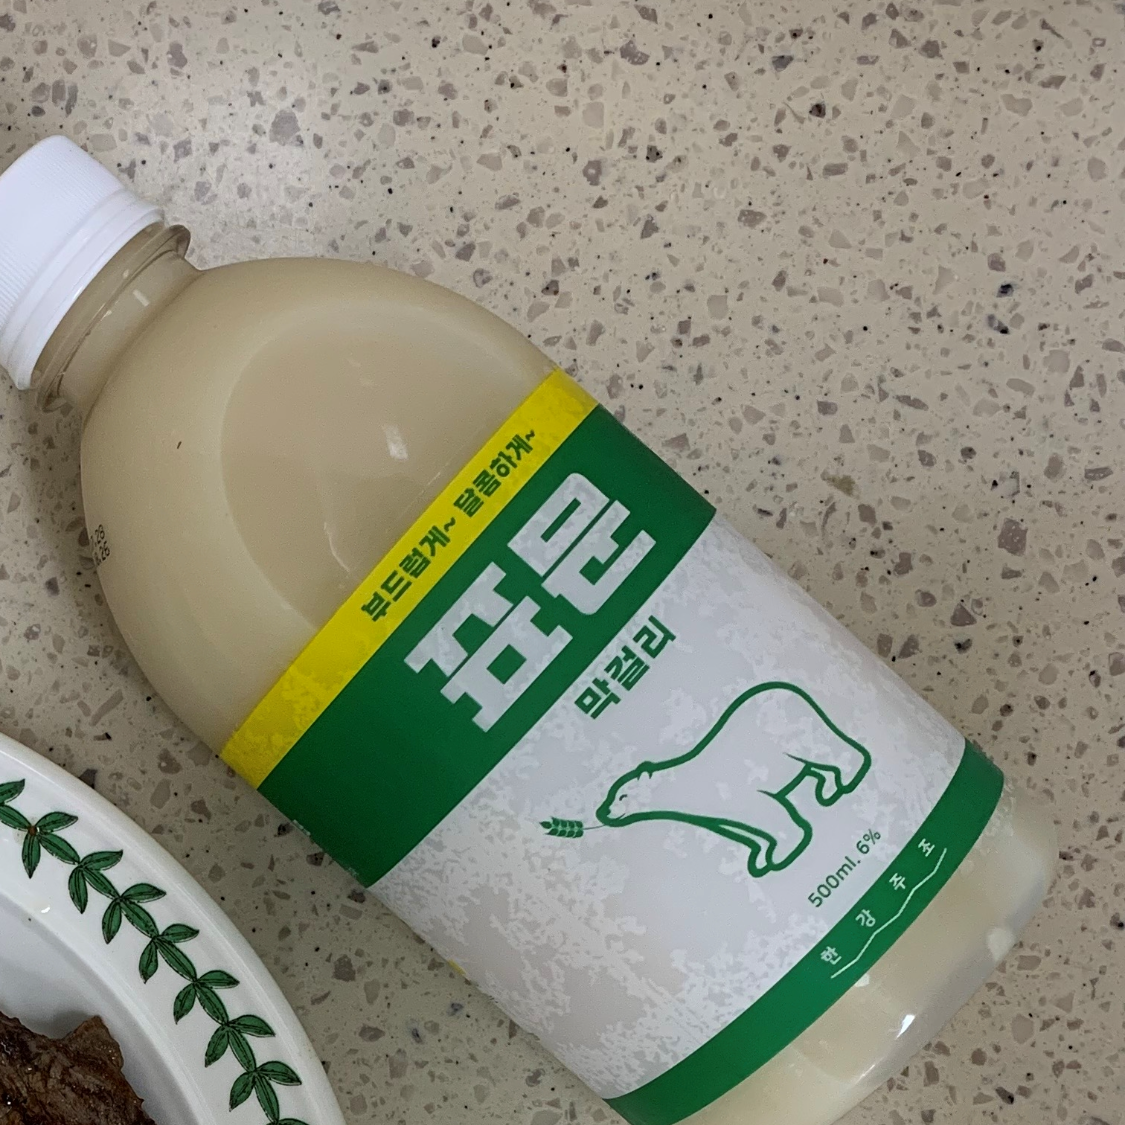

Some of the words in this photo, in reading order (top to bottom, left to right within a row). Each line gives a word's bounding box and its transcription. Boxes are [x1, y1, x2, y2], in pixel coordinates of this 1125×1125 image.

[360, 517, 457, 622] 부드럽게~
[453, 429, 537, 518] 달콤하게~
[403, 472, 657, 733] 표문
[574, 615, 677, 720] 막걸리
[855, 828, 882, 855] 6%
